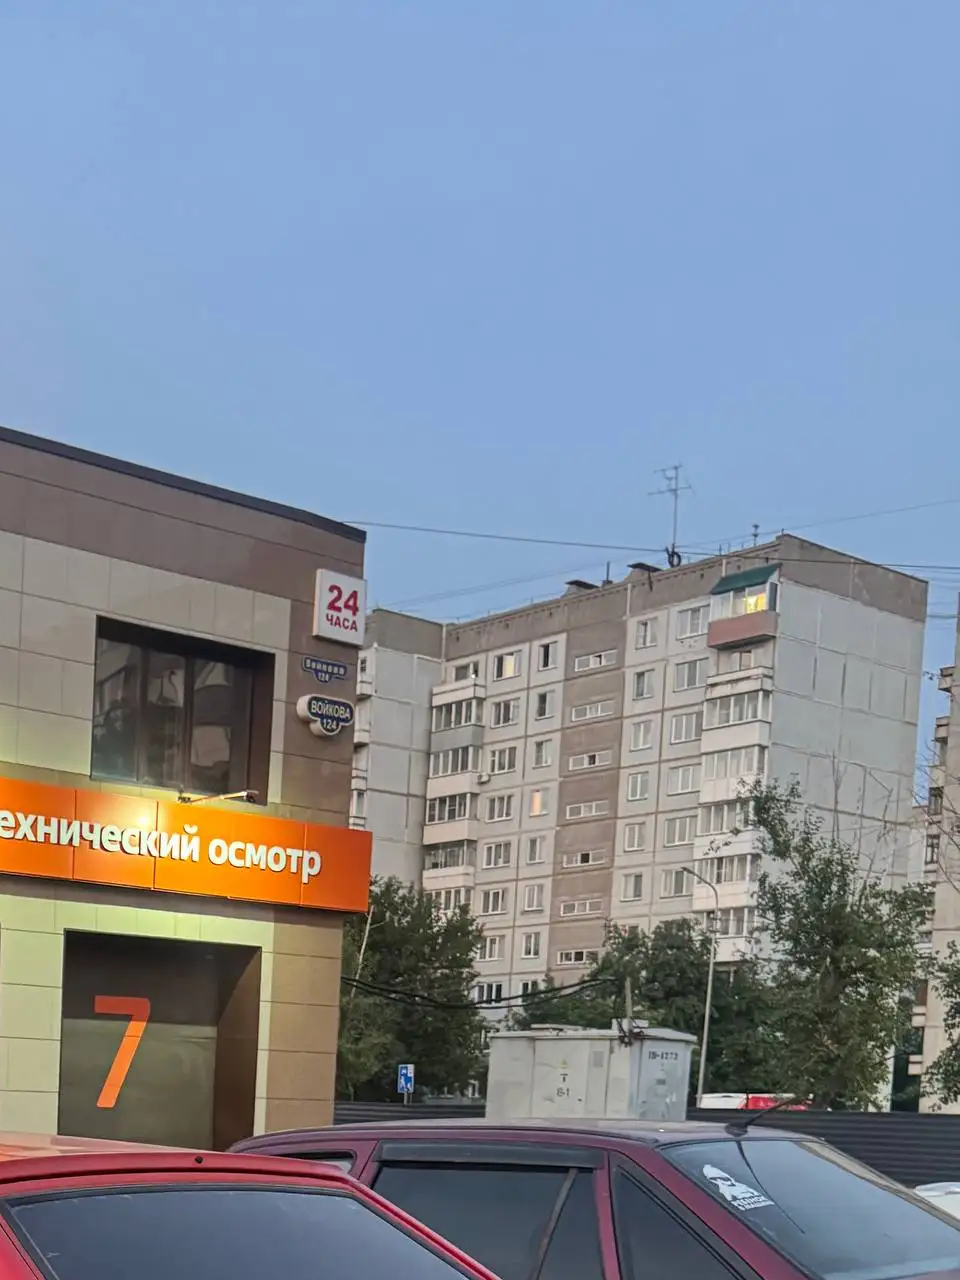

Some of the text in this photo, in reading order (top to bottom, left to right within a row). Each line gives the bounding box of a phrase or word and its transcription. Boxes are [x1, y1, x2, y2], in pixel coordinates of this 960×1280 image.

[327, 583, 359, 616] 24
[326, 612, 358, 632] ЧАСА
[311, 700, 351, 720] ВОЙКОВА
[323, 719, 337, 729] 124
[208, 837, 321, 884] осмотр
[94, 995, 151, 1108] 7
